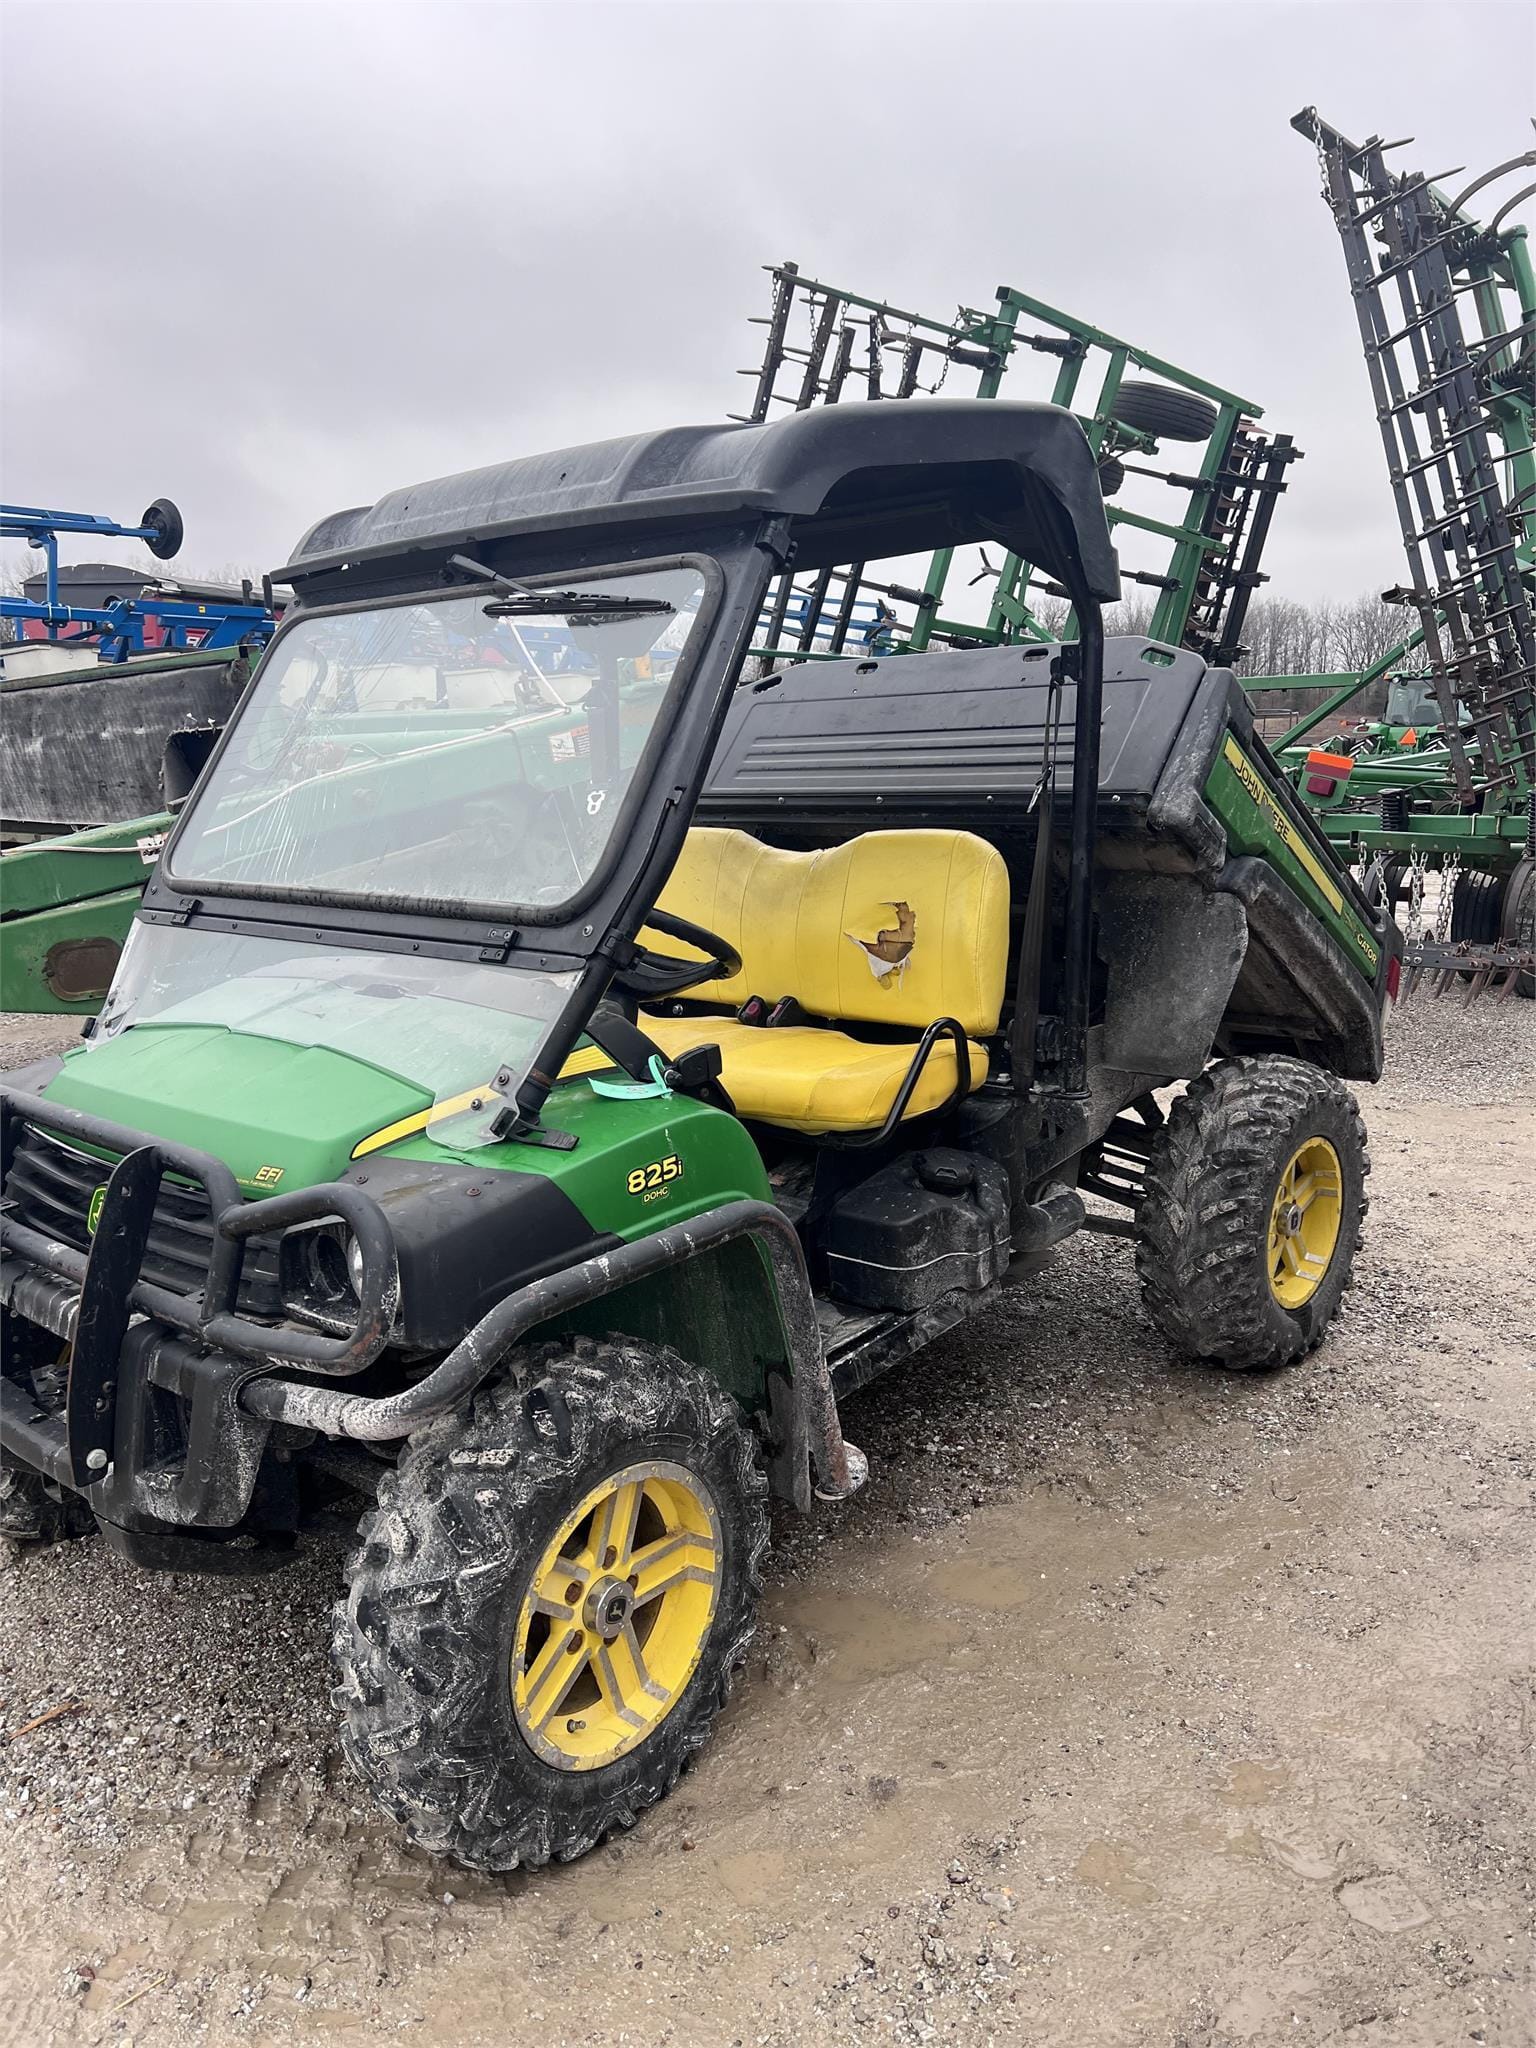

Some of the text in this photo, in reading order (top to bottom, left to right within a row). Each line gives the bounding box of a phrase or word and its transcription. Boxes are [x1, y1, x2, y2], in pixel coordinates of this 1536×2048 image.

[1235, 759, 1290, 842] JOHN DERE
[1357, 933, 1377, 965] GATOR
[255, 1165, 284, 1183] EFI
[627, 1154, 683, 1195] 825i
[643, 1186, 669, 1203] DOHC
